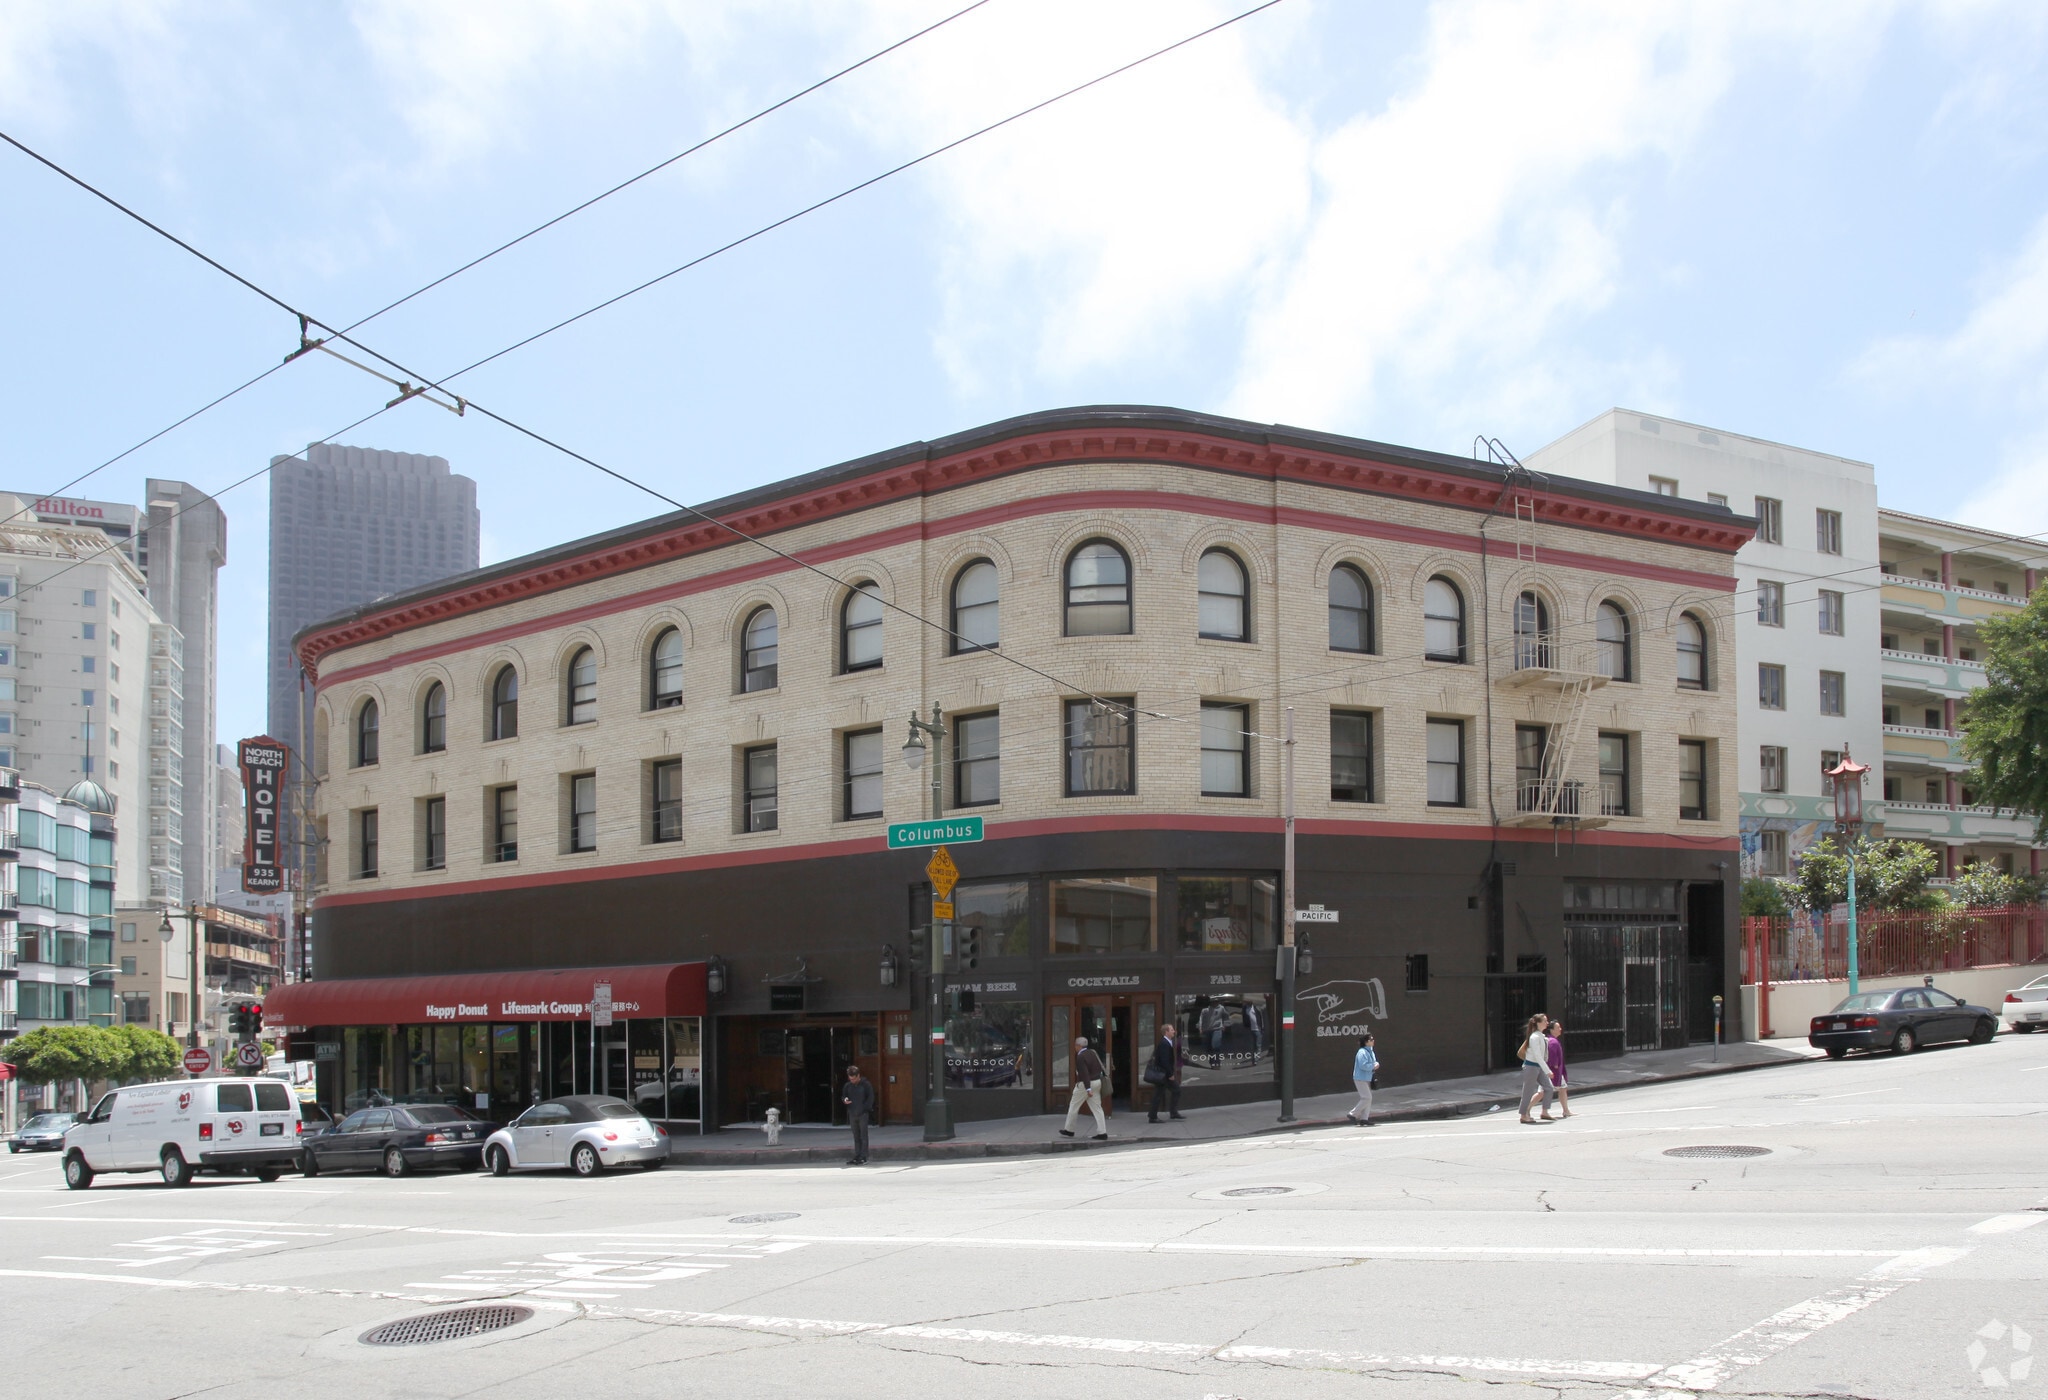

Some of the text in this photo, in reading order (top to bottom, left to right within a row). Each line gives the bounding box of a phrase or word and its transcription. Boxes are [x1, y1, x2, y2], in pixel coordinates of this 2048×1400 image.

[35, 498, 104, 518] Hilton
[245, 747, 283, 759] NORTH
[245, 756, 283, 767] BEACH
[254, 769, 274, 865] HOTEL
[898, 825, 972, 842] Columbus
[253, 868, 274, 877] 935
[247, 878, 280, 887] KEARNY
[1301, 912, 1332, 920] PACIFIC
[1067, 975, 1140, 987] COCKTAILS
[1210, 974, 1242, 985] FARE
[986, 982, 1017, 992] BEER
[426, 1003, 488, 1019] Happy Donut
[501, 1001, 583, 1017] Lifemark Group
[1316, 1024, 1370, 1037] SALOON
[317, 1044, 337, 1054] ATM
[1191, 1052, 1261, 1061] COMSTOCK
